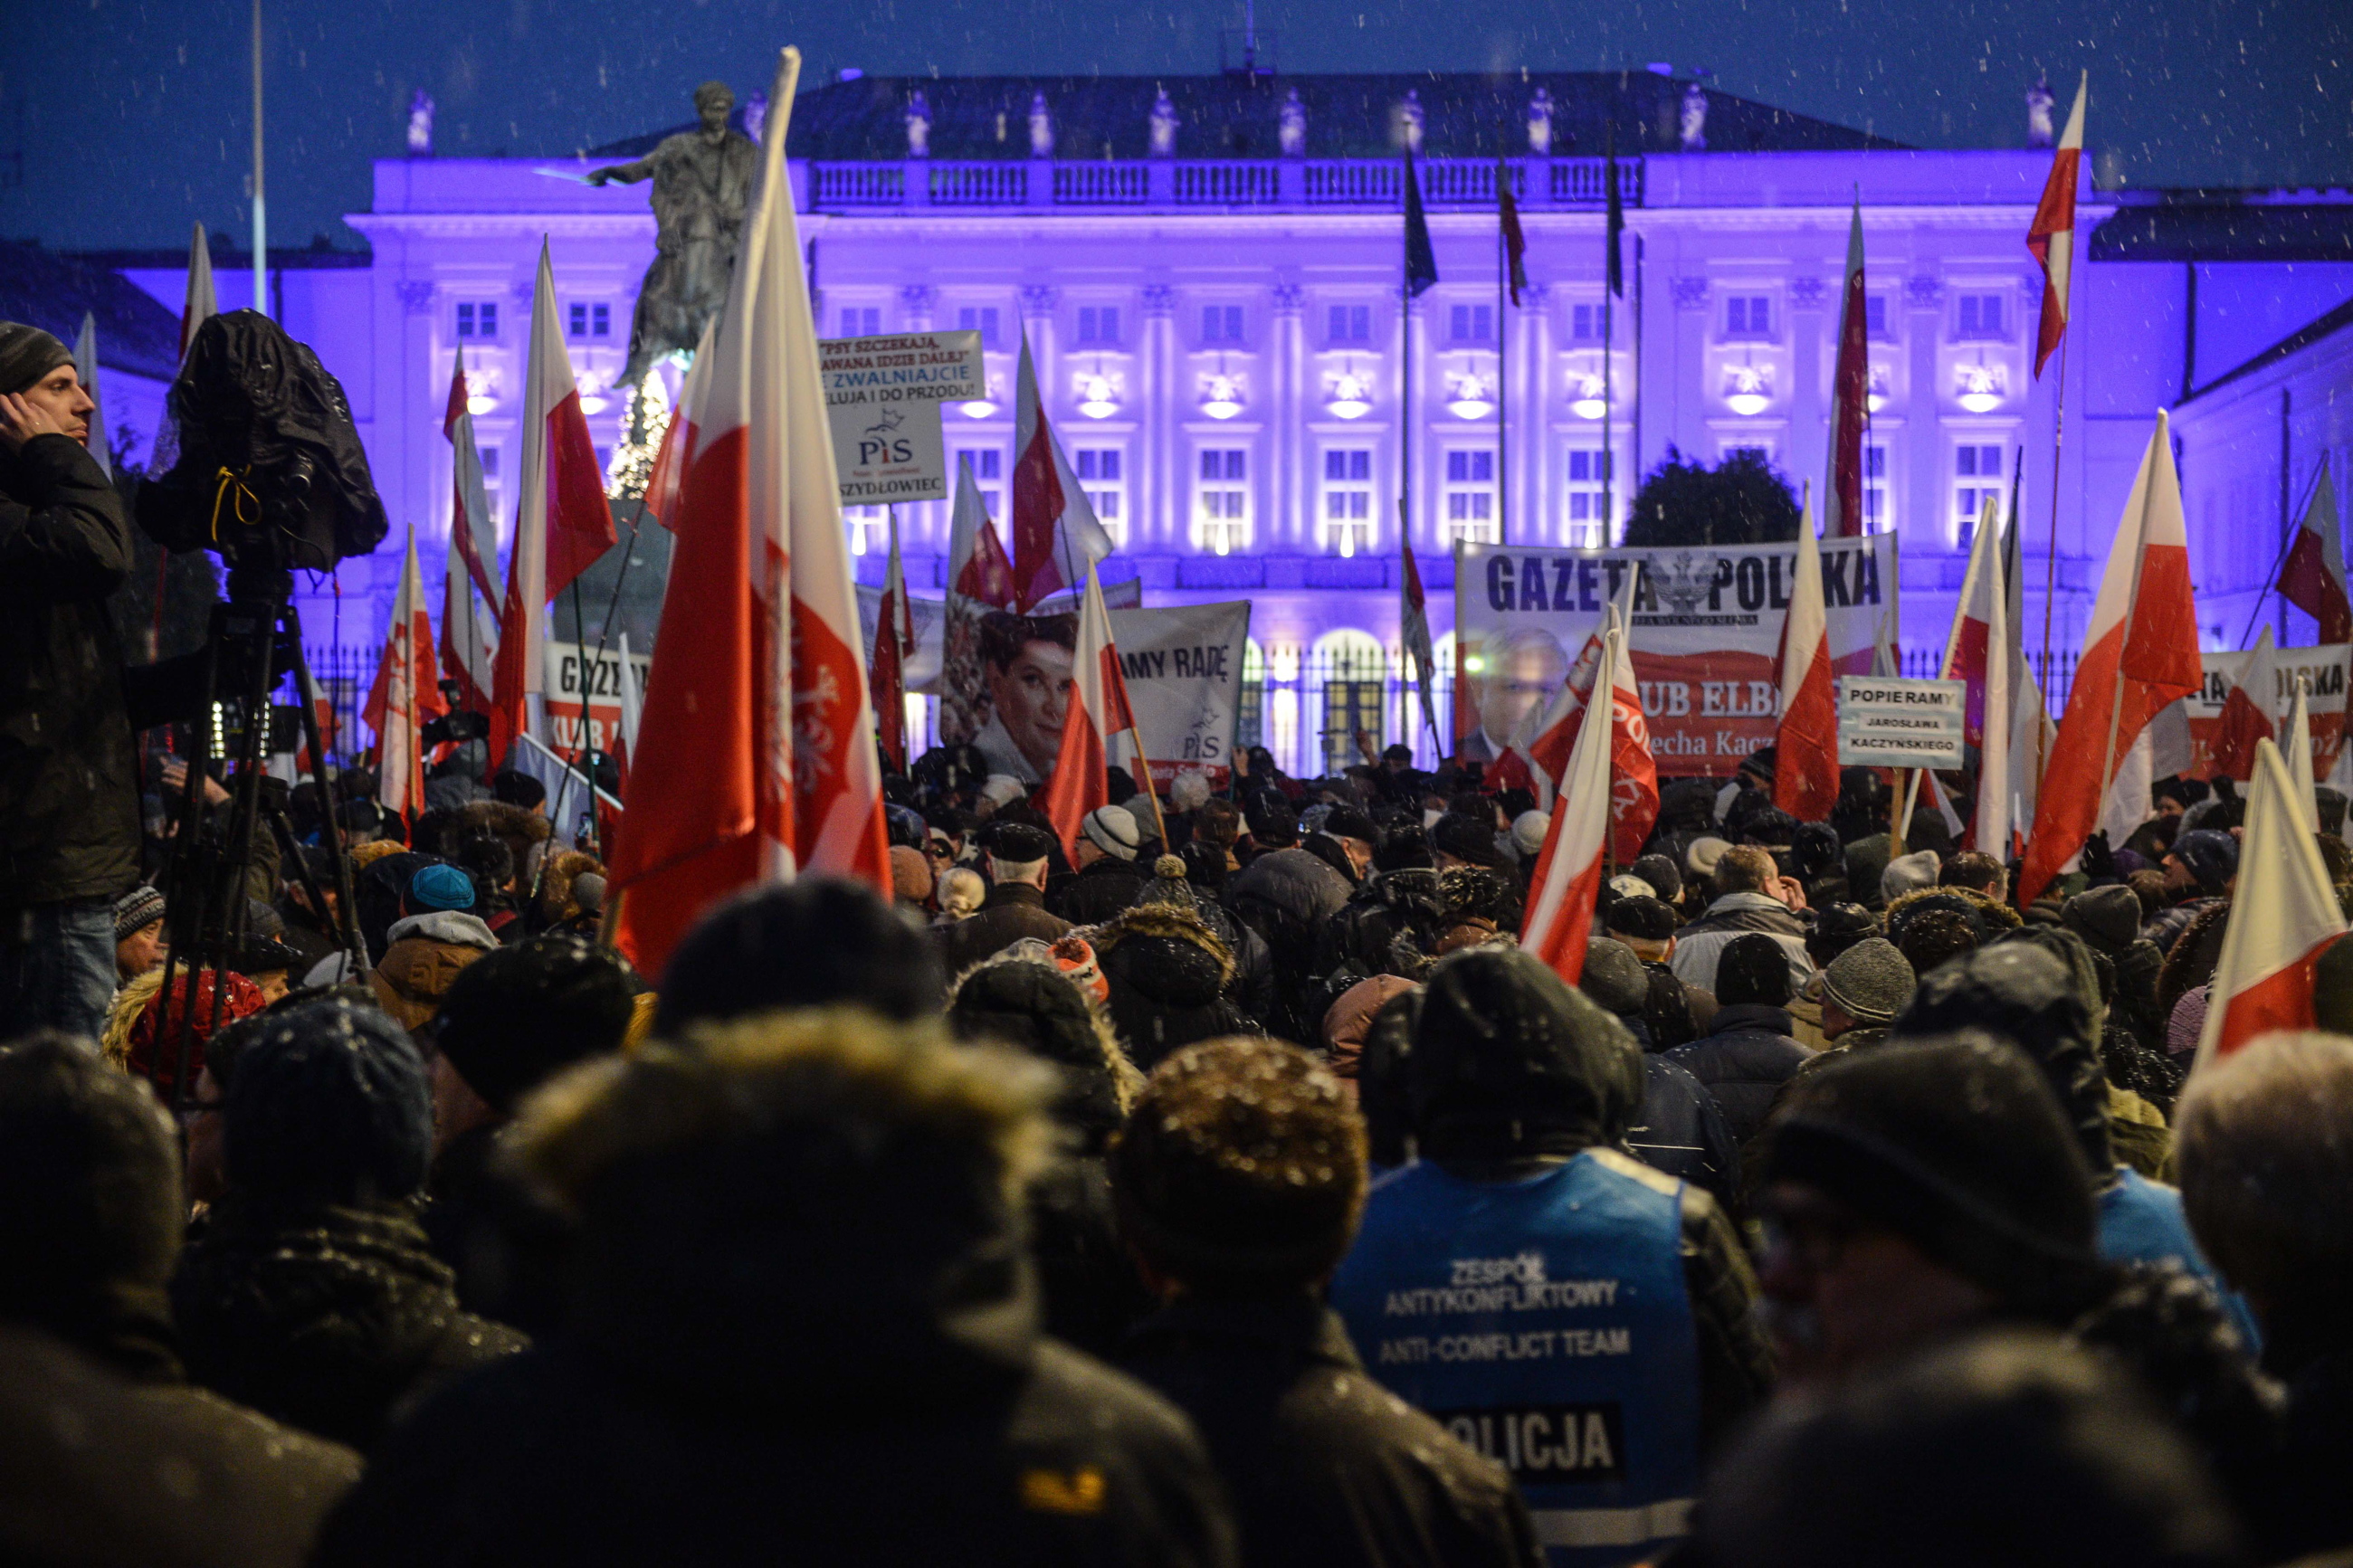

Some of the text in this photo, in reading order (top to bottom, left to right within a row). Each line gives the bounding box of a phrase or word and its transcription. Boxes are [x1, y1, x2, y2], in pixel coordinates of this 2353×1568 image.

[822, 356, 873, 372] AWANA
[877, 354, 916, 369] IDZIE
[834, 366, 970, 388] ZWALNIAJCIE
[871, 390, 876, 403] I
[880, 388, 902, 402] DO
[907, 384, 976, 401] PRZODU!
[859, 438, 913, 467] PiS
[1709, 548, 1881, 610] POLKA
[1118, 644, 1228, 682] AMY RADĘ
[1638, 681, 1691, 717] UB
[1851, 689, 1955, 705] POPIERAMY
[1868, 717, 1939, 728] JAROSŁAWA
[1183, 734, 1219, 759] PiS
[1651, 729, 1776, 755] echa Kacz
[1851, 736, 1954, 750] KACZYŃSKIEGO
[1386, 1281, 1617, 1315] ANTYKONFLIKTOWY
[1379, 1327, 1630, 1363] ANTI-CONFLICT TEAM
[1449, 1413, 1614, 1469] OLICJA
